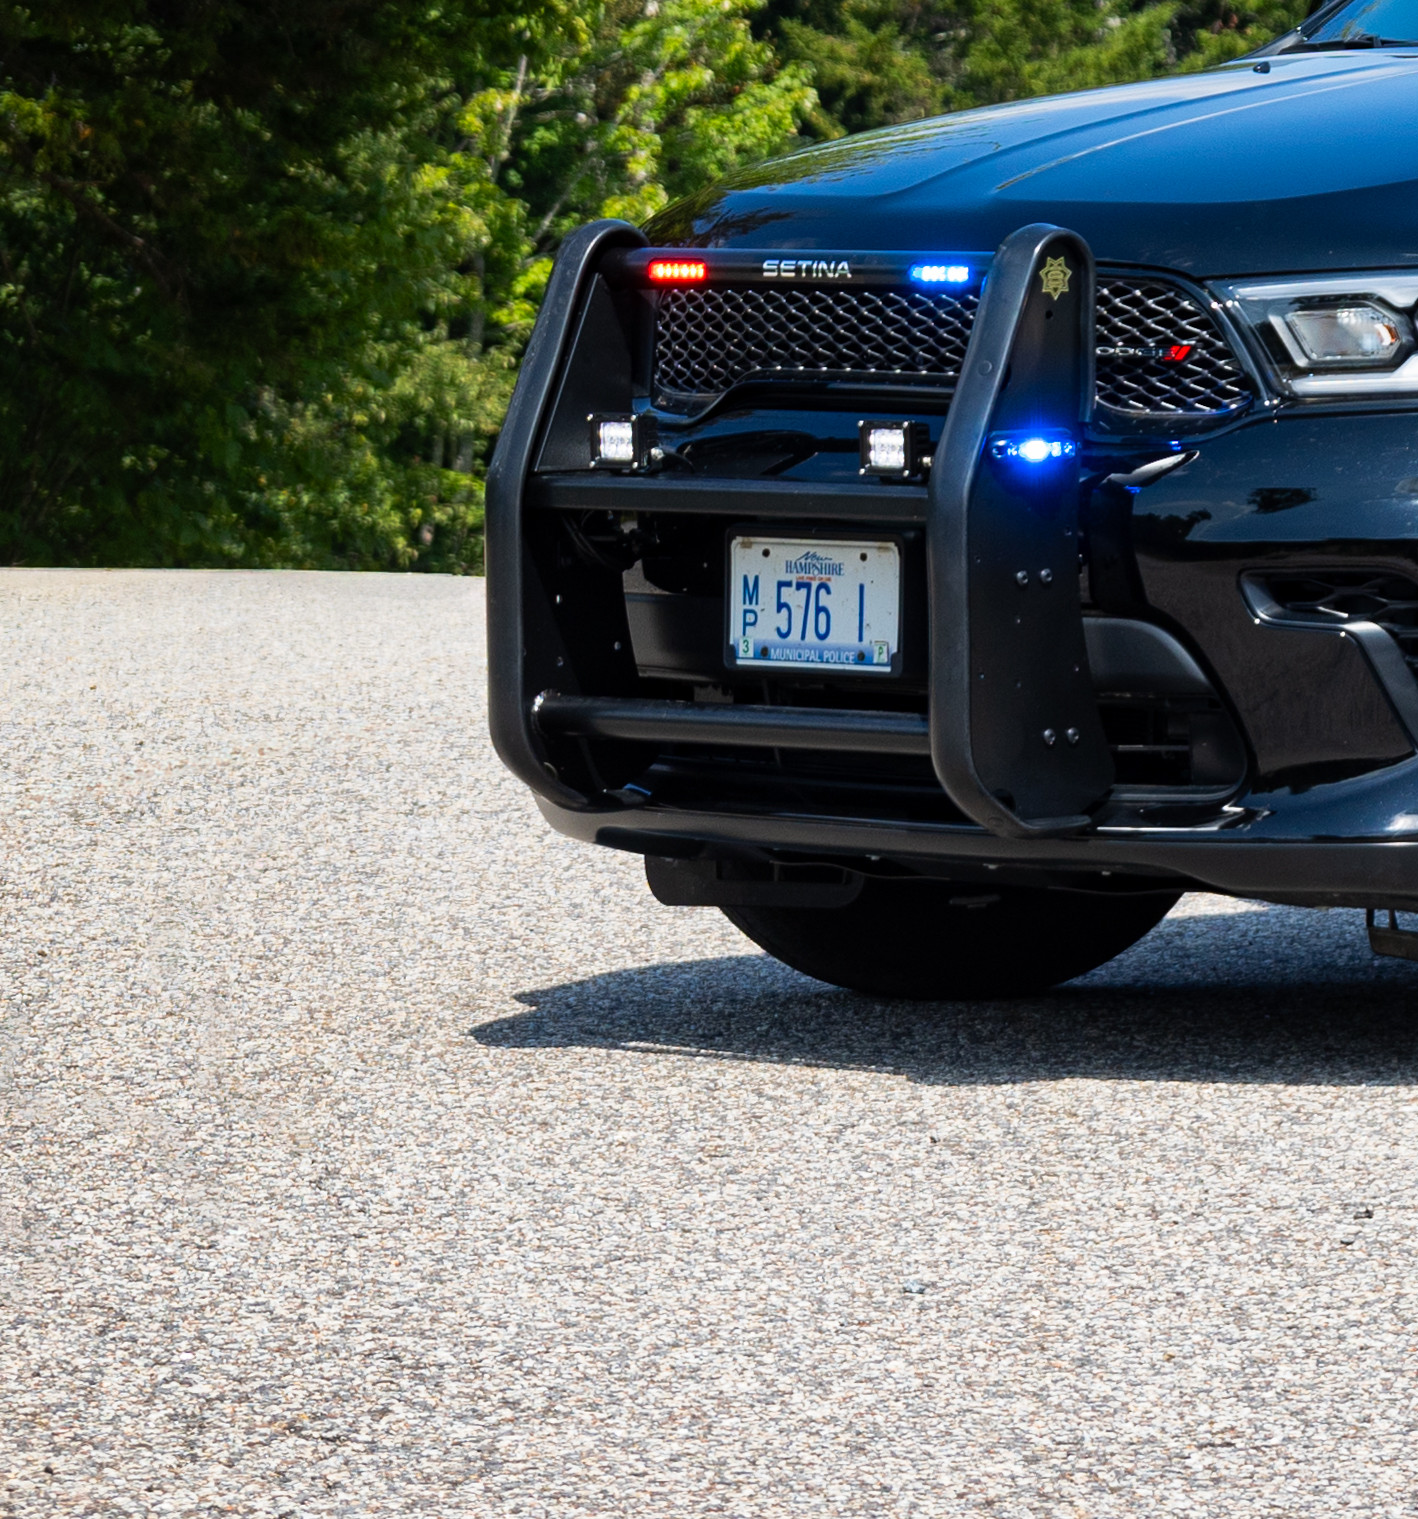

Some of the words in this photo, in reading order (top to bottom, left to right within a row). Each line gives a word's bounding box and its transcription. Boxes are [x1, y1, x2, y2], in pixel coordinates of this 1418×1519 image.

[762, 259, 852, 278] SETINA
[785, 559, 845, 577] HAMPSHIRE
[776, 580, 832, 641] 576
[742, 639, 750, 654] 3
[770, 647, 821, 662] MUNICIPAL
[823, 649, 856, 664] POLICE
